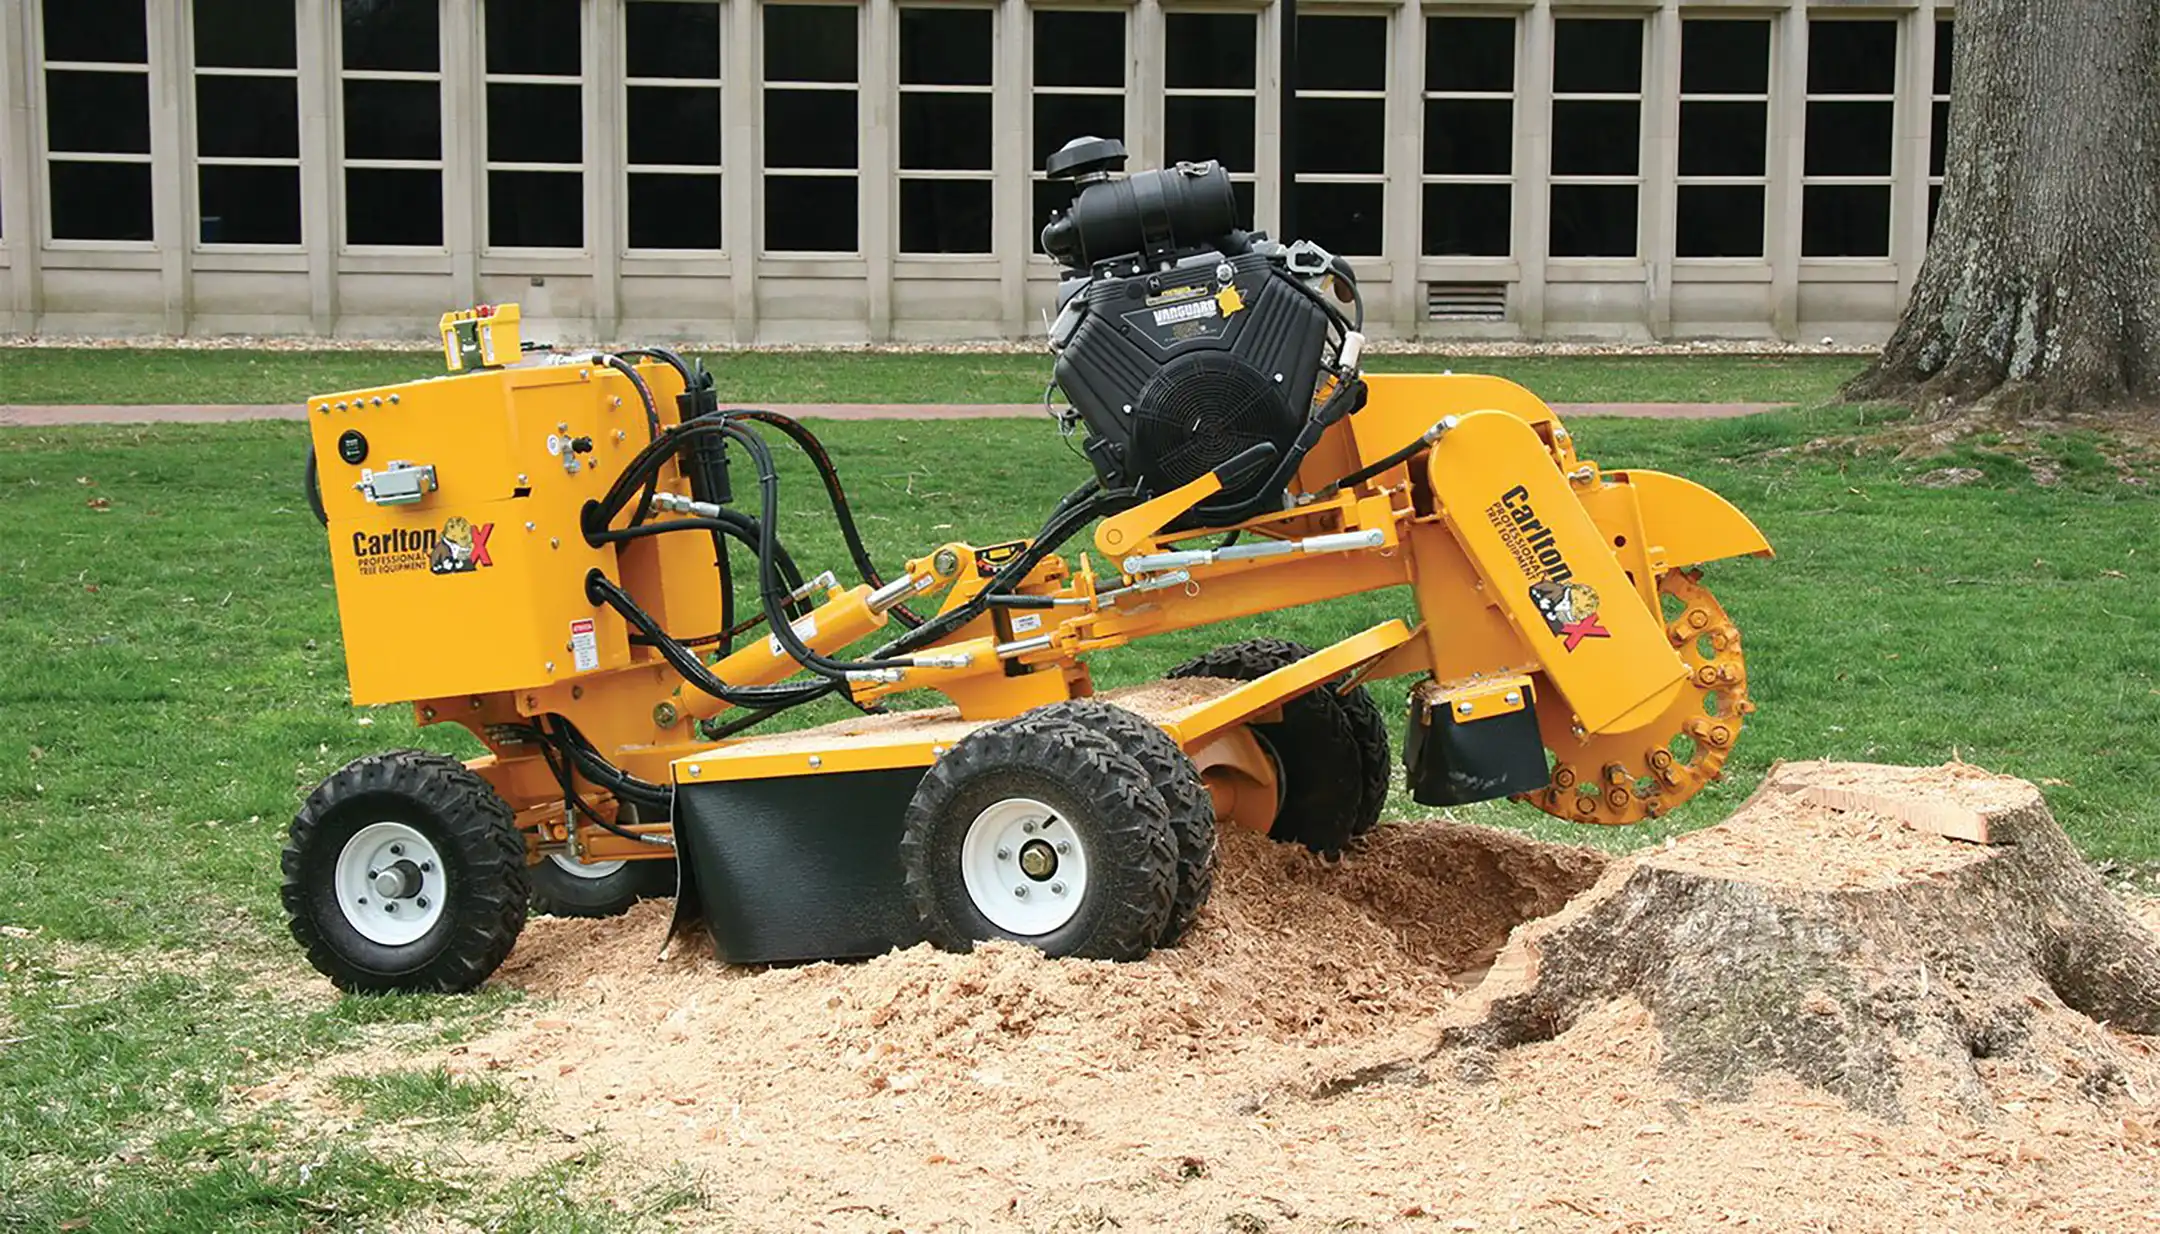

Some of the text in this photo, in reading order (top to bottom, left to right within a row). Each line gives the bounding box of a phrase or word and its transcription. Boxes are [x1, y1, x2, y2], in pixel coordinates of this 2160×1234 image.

[1153, 299, 1216, 323] VANGUARD
[353, 528, 437, 557] Carlton
[1485, 507, 1538, 581] TREE EQUIPMENT
[1493, 501, 1546, 582] PROFESSIONAL
[1501, 484, 1573, 583] Carlton
[358, 552, 427, 566] PROFESSIONAL
[360, 561, 427, 575] TREE EQUIPMENT
